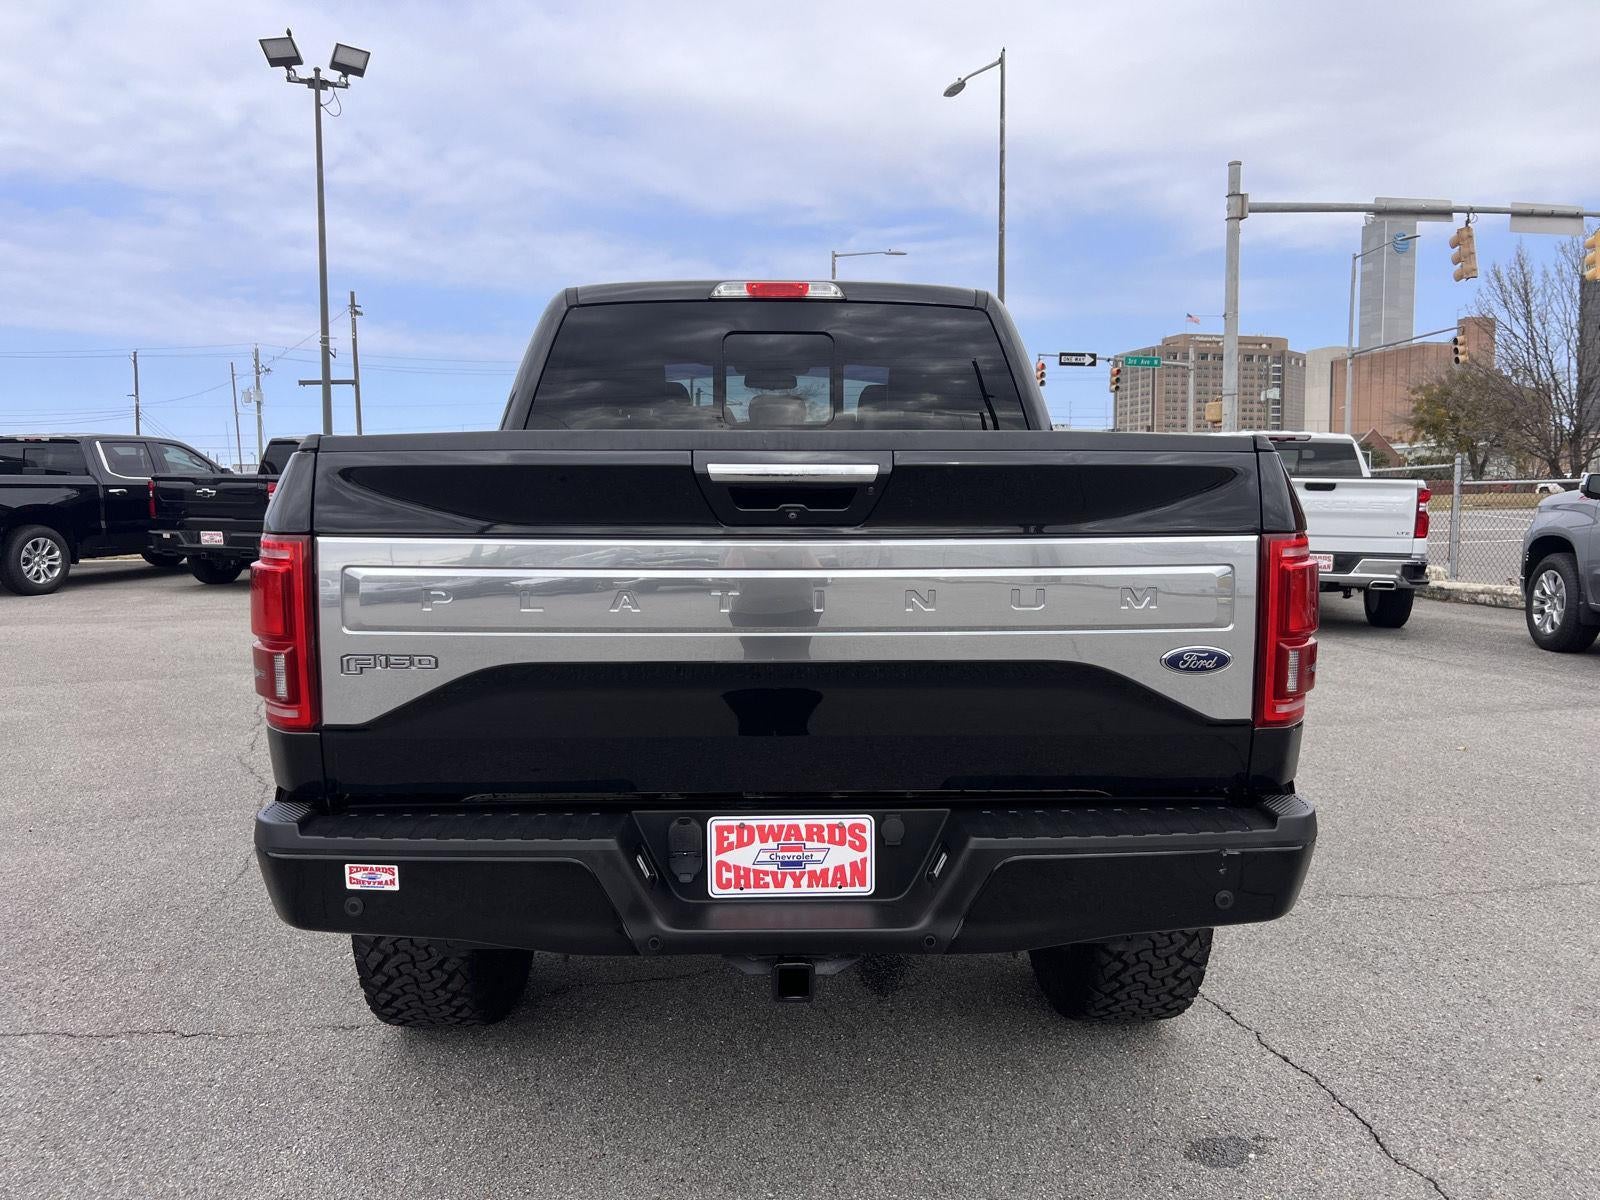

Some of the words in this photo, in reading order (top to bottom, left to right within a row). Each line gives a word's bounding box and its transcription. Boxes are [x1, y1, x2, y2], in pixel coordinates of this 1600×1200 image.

[421, 586, 1159, 613] PLATINUM
[1178, 652, 1218, 669] Ford
[714, 822, 868, 857] EDWARDS
[768, 852, 814, 862] Chevrolet
[348, 865, 396, 876] EDWARDS
[714, 857, 868, 891] CHEVYMAN
[349, 876, 396, 886] CHEVYMAN
